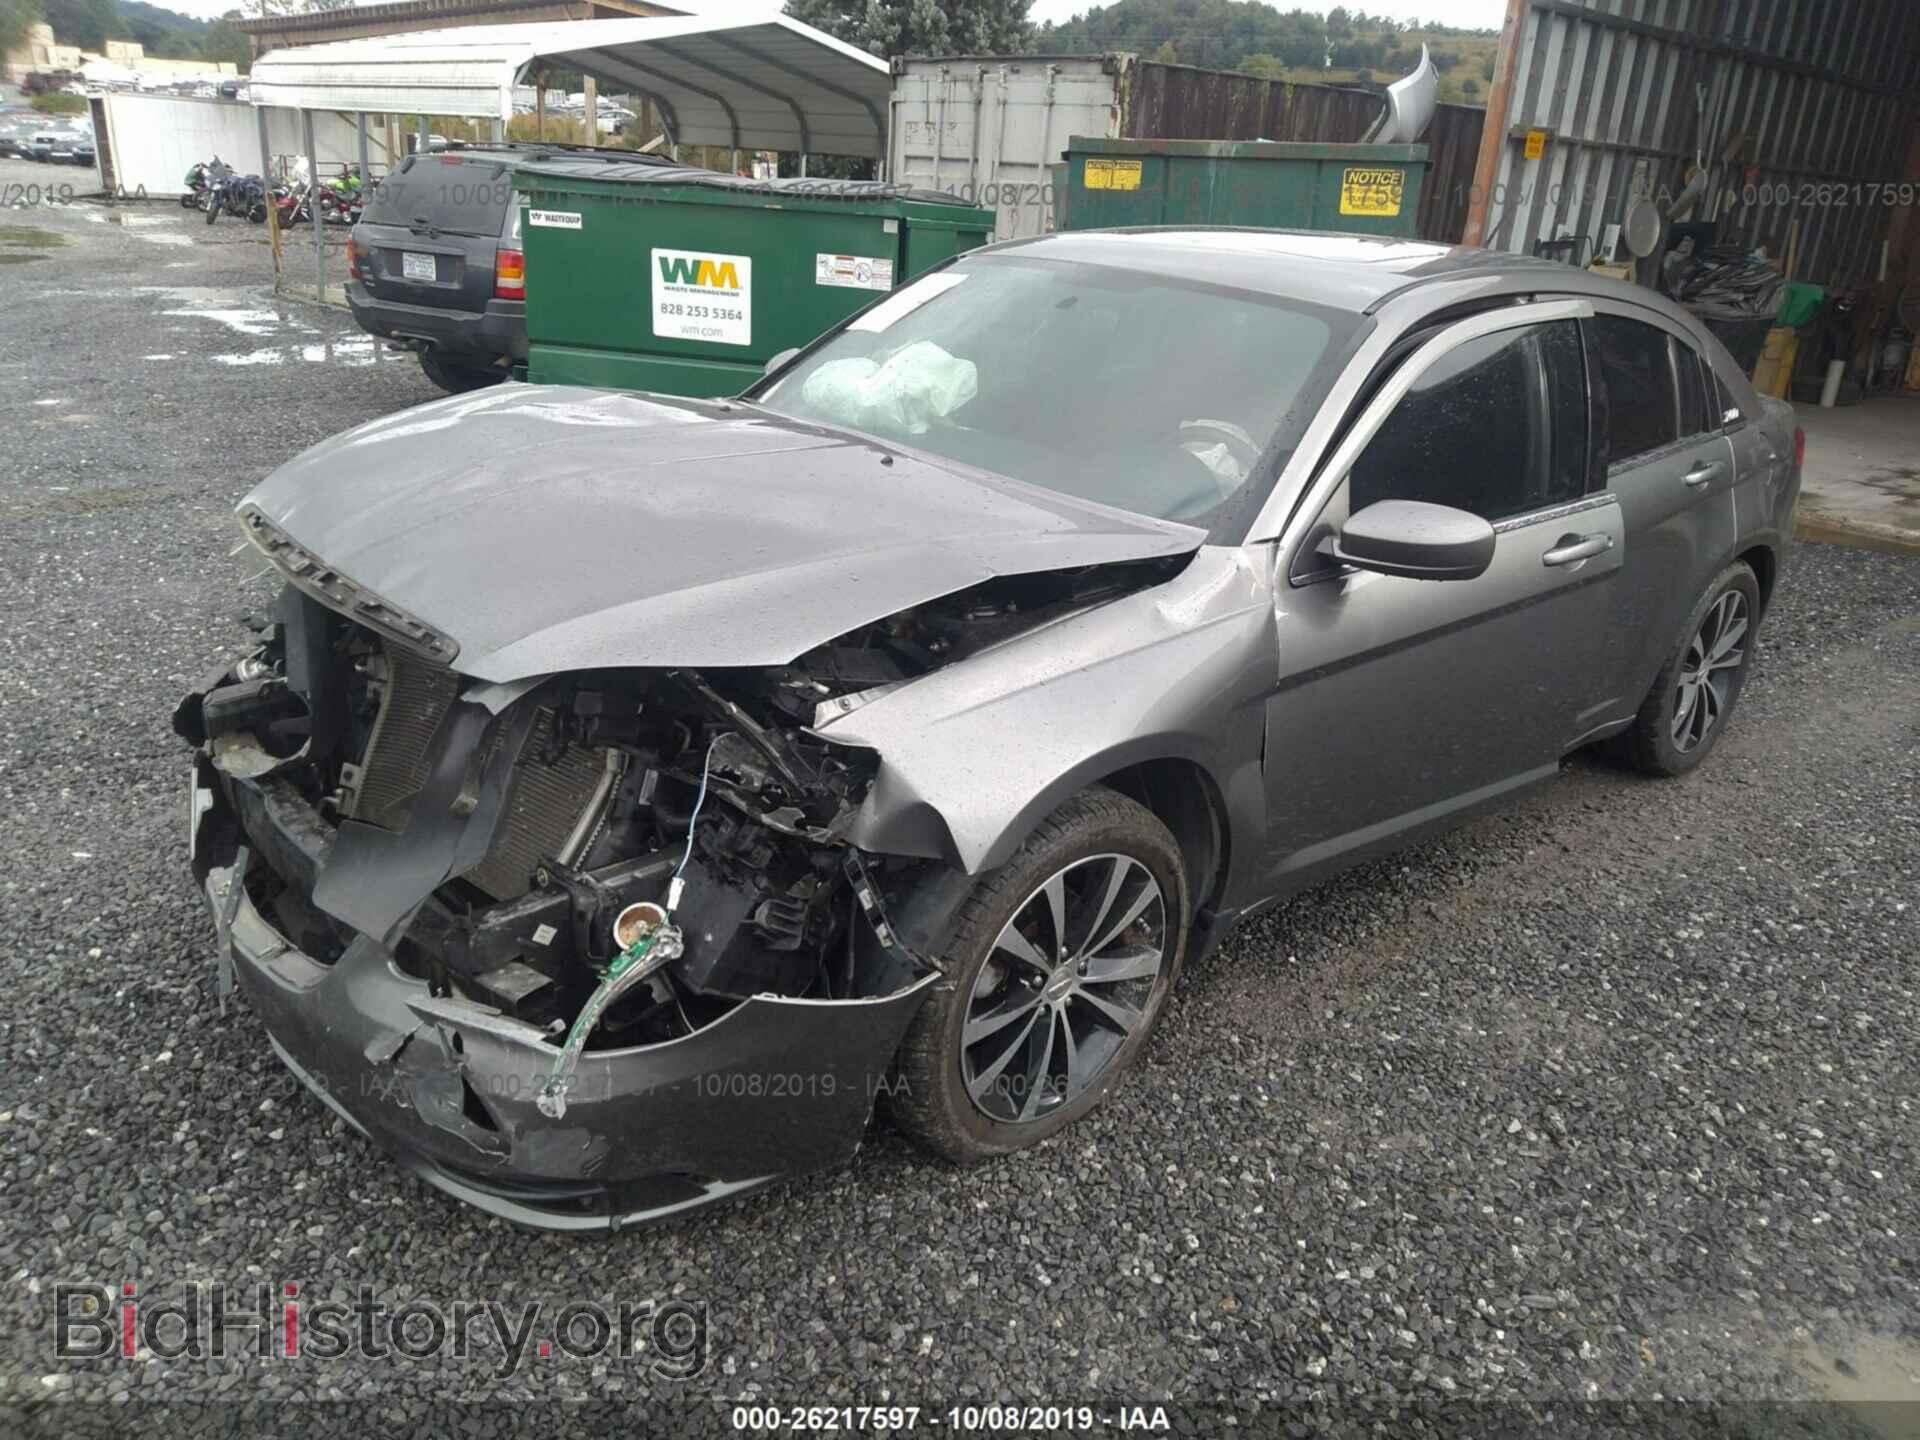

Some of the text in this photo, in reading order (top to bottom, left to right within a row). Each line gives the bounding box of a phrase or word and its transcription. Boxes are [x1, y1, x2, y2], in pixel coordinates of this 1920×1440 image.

[1347, 171, 1401, 185] NOTICE
[658, 255, 739, 289] WM
[660, 303, 743, 321] 828 253 5364
[679, 325, 724, 337] wmcom
